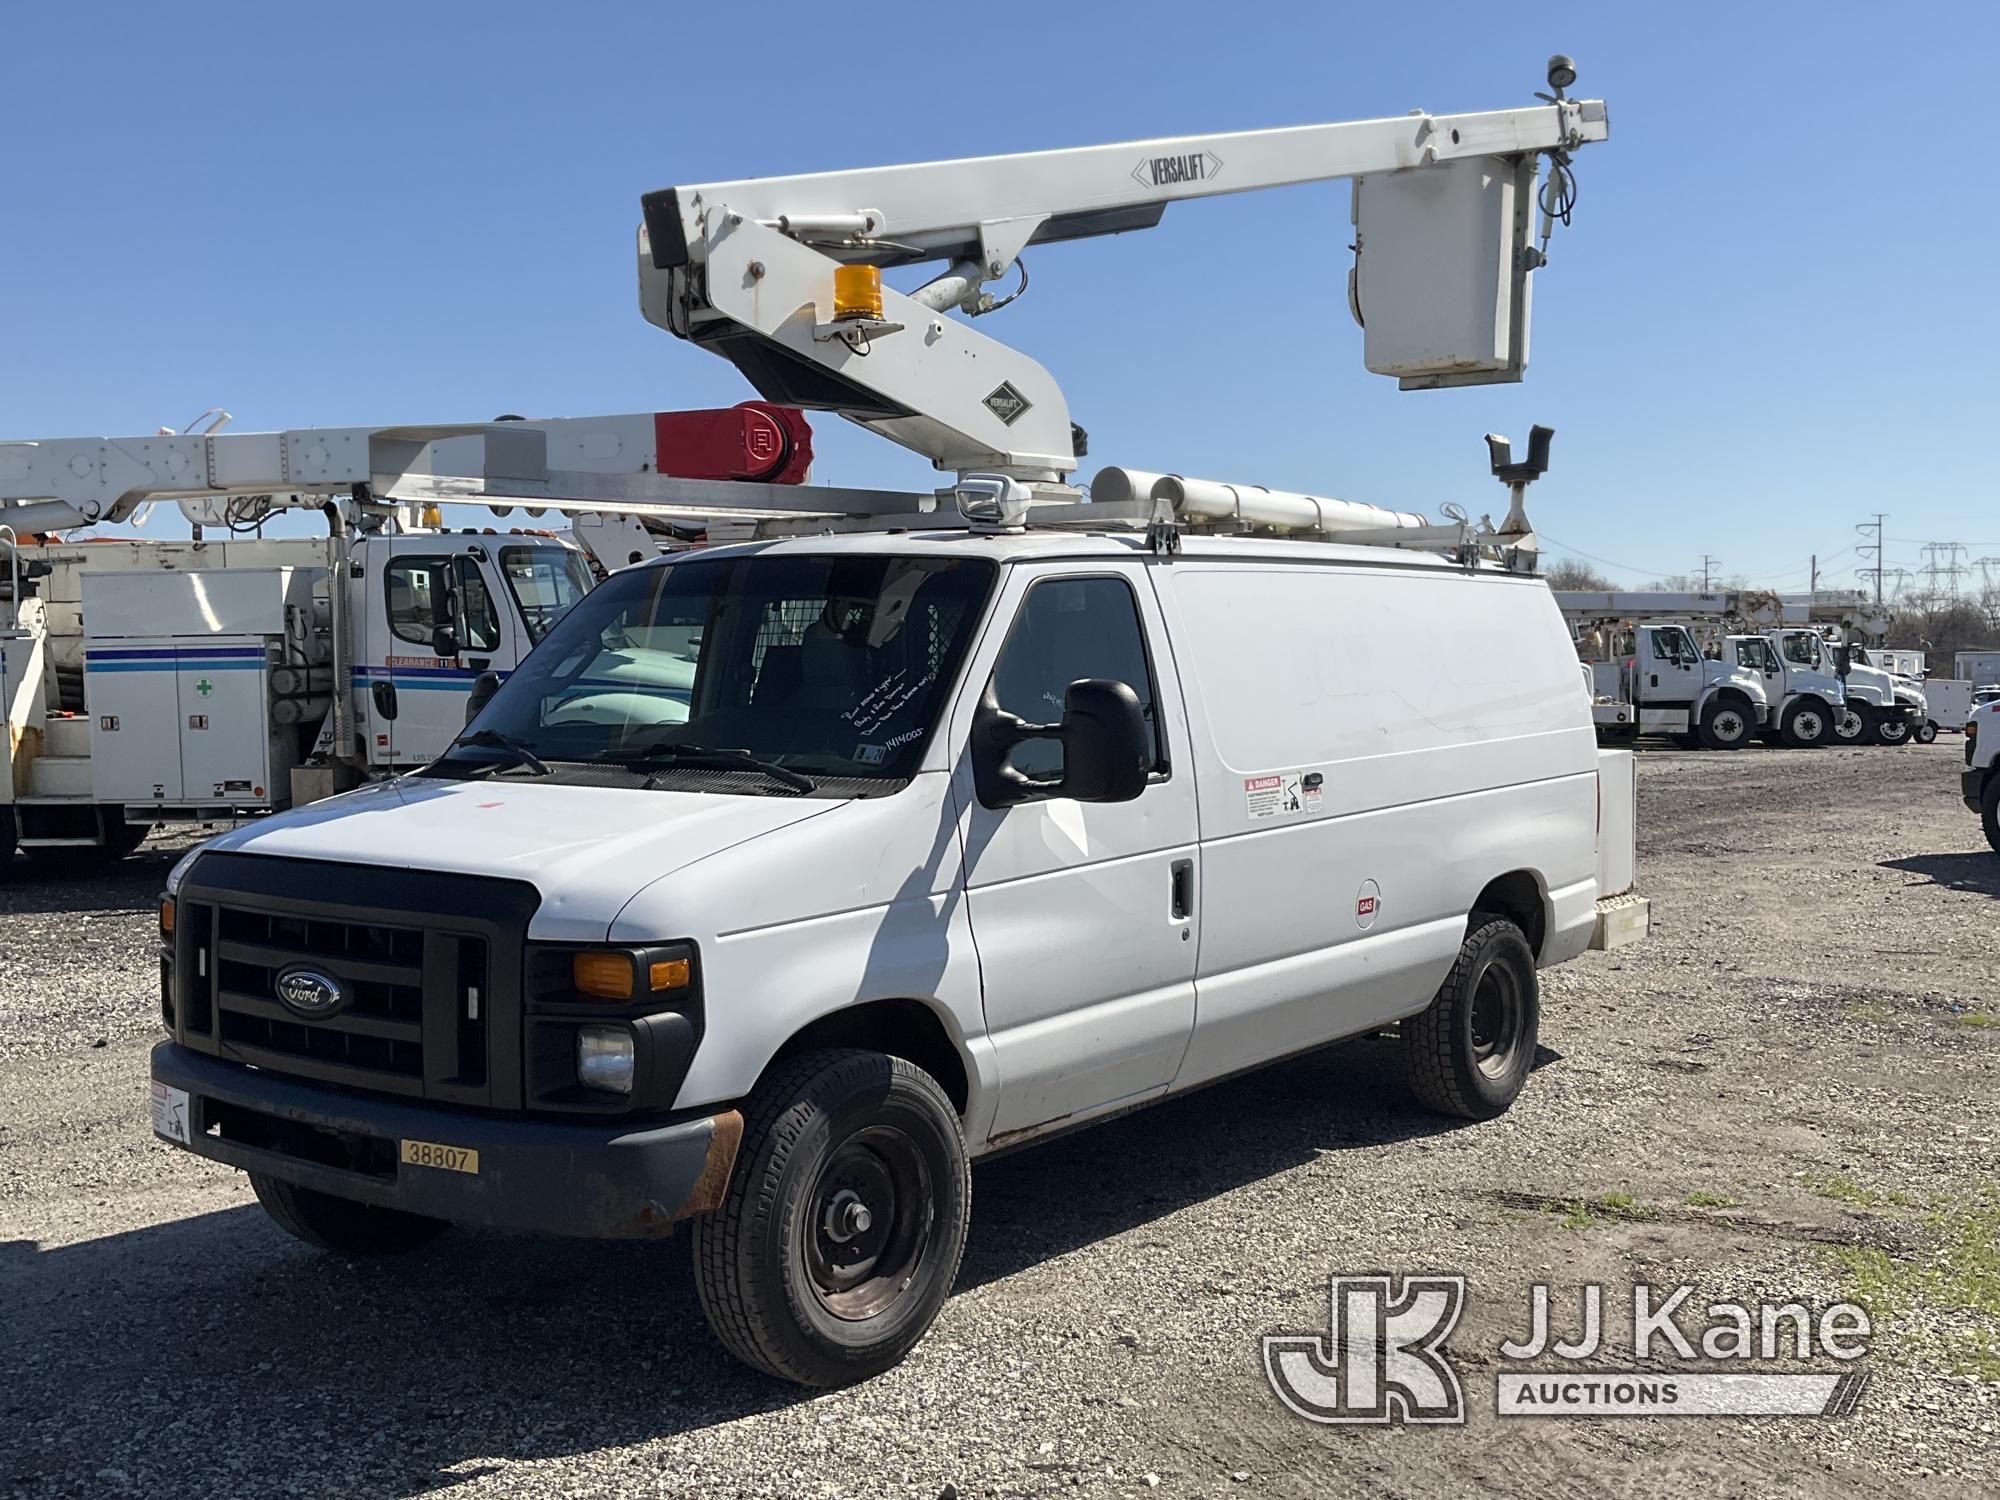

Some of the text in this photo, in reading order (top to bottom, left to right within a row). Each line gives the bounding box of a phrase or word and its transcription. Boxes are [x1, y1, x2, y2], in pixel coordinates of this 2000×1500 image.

[1149, 153, 1205, 186] VERSALIFT
[885, 728, 925, 751] 1414005
[1255, 777, 1279, 789] DANGER
[1359, 900, 1373, 912] GAS
[288, 978, 324, 1003] Ford
[409, 1143, 469, 1170] 38807
